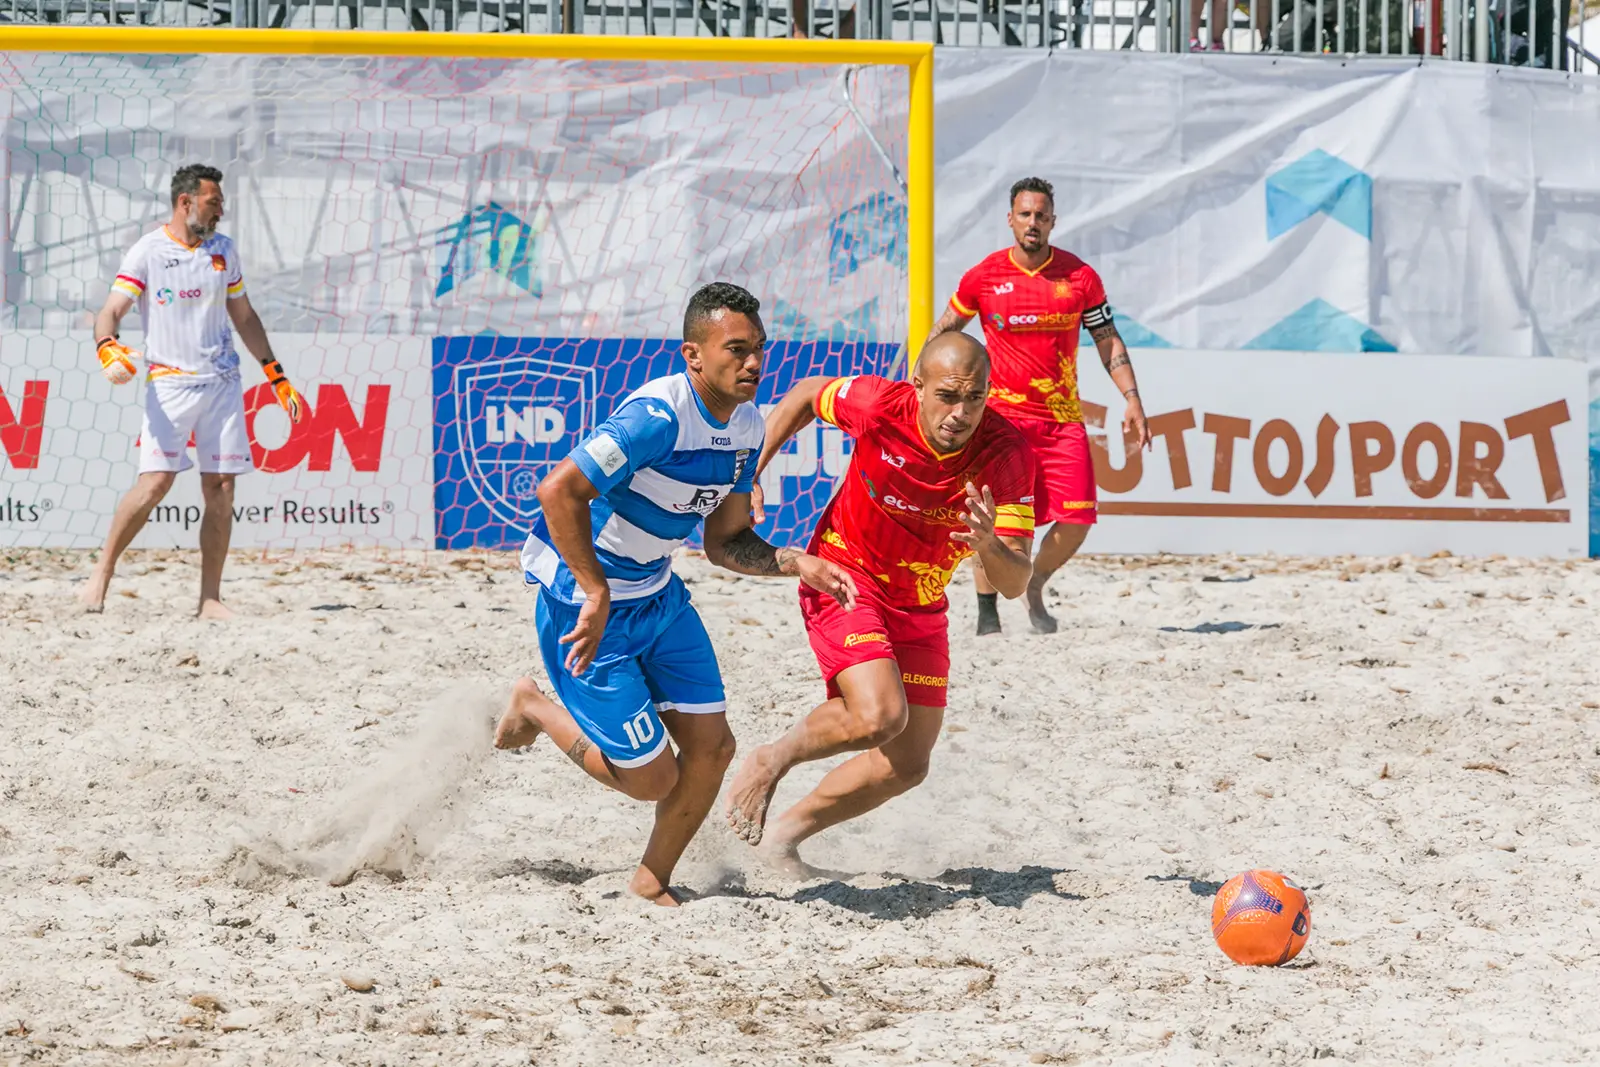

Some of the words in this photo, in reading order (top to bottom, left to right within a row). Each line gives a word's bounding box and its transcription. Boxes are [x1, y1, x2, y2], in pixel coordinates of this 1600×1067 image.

[135, 384, 391, 473] ON
[486, 403, 566, 448] LND
[622, 711, 655, 750] 10
